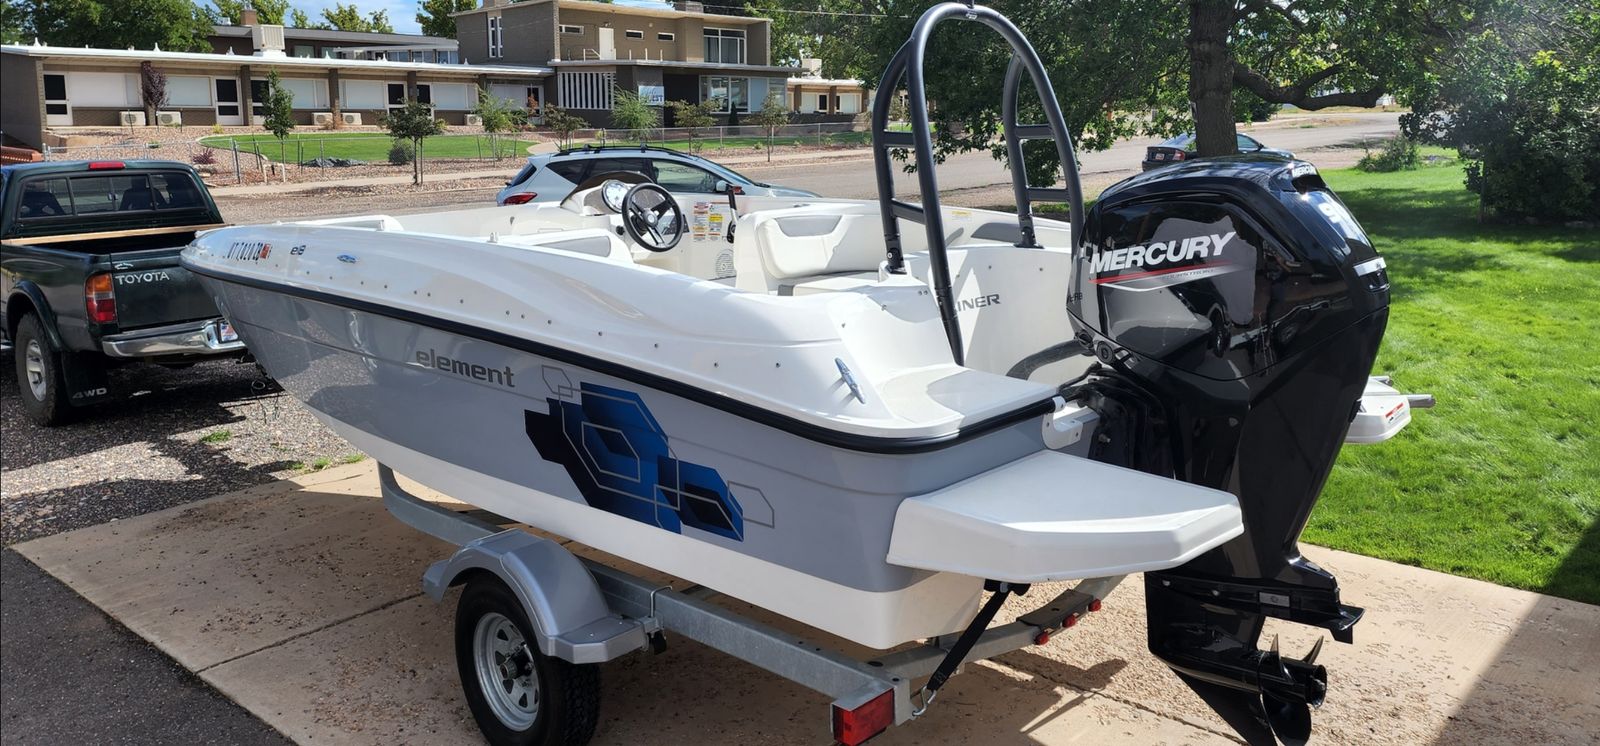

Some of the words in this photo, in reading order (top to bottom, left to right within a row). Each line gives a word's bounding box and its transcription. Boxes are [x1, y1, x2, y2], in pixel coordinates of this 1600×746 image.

[1089, 231, 1236, 274] MERCURY
[115, 271, 170, 285] TOYOTA
[957, 294, 1001, 312] INER
[416, 348, 515, 388] element
[72, 387, 107, 399] 4WD
